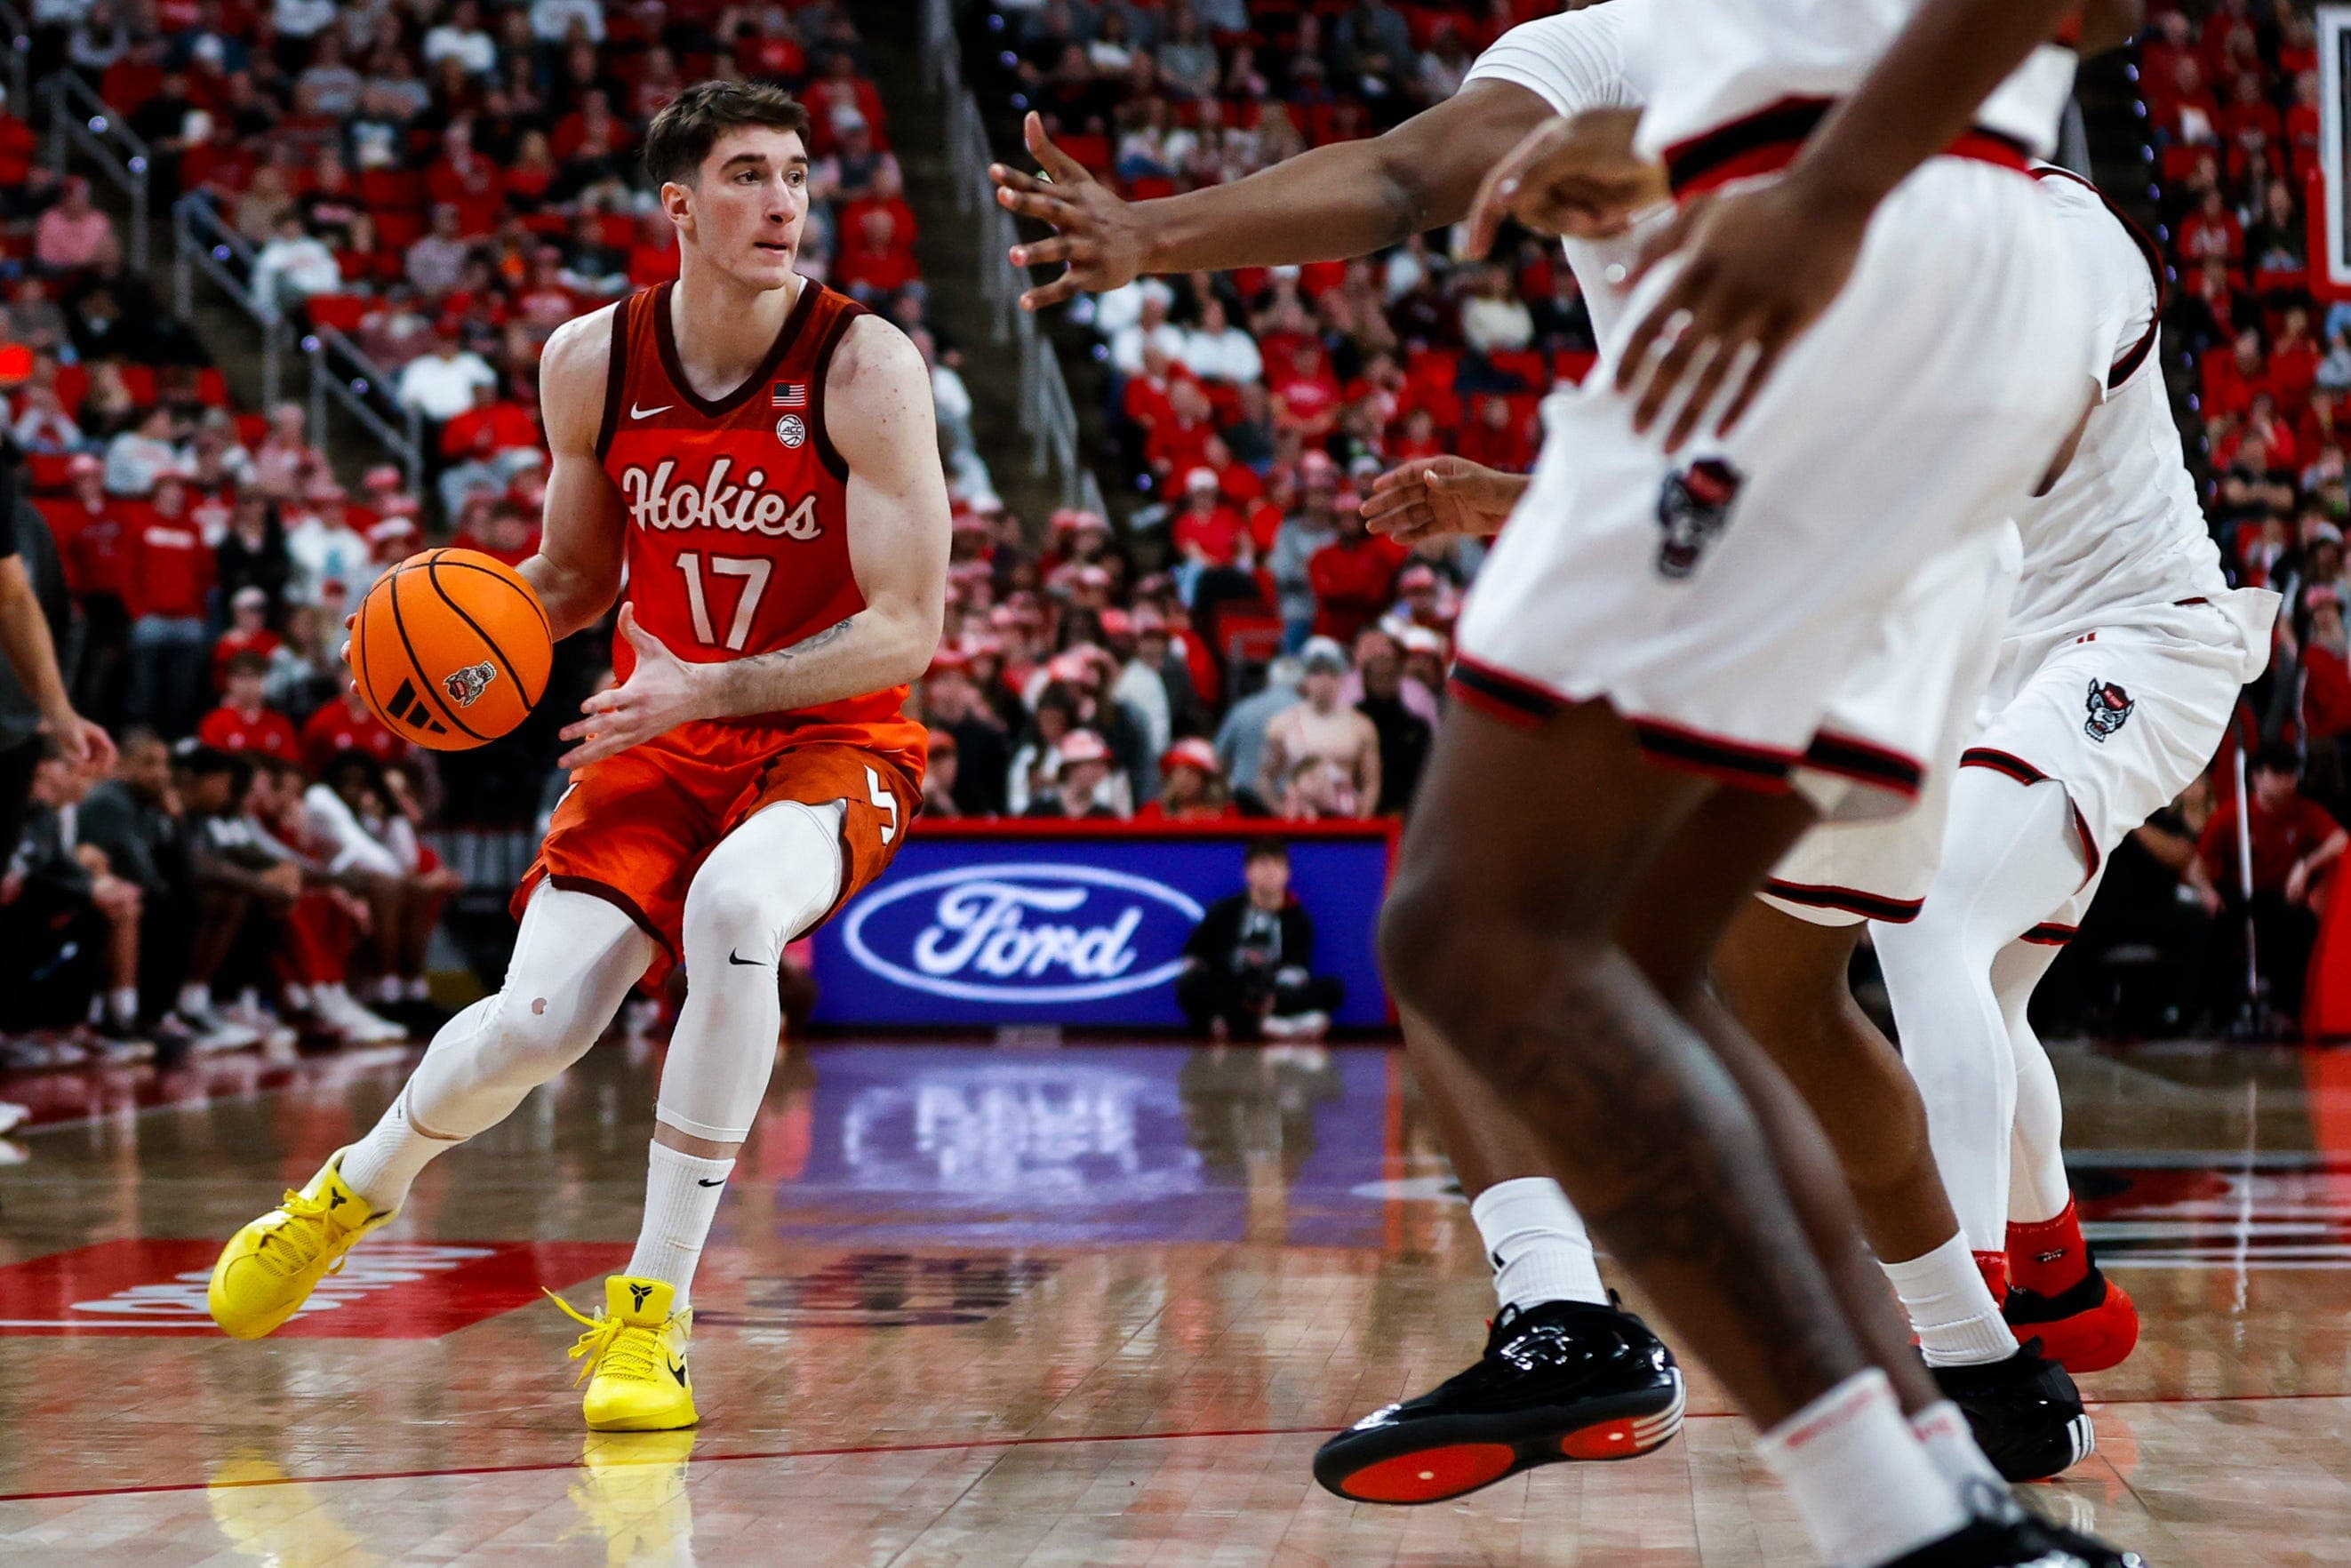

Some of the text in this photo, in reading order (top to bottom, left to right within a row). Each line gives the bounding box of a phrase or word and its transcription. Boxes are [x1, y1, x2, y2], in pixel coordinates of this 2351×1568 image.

[623, 459, 821, 540] Hokies
[676, 552, 772, 652] 17
[913, 880, 1144, 977] Ford
